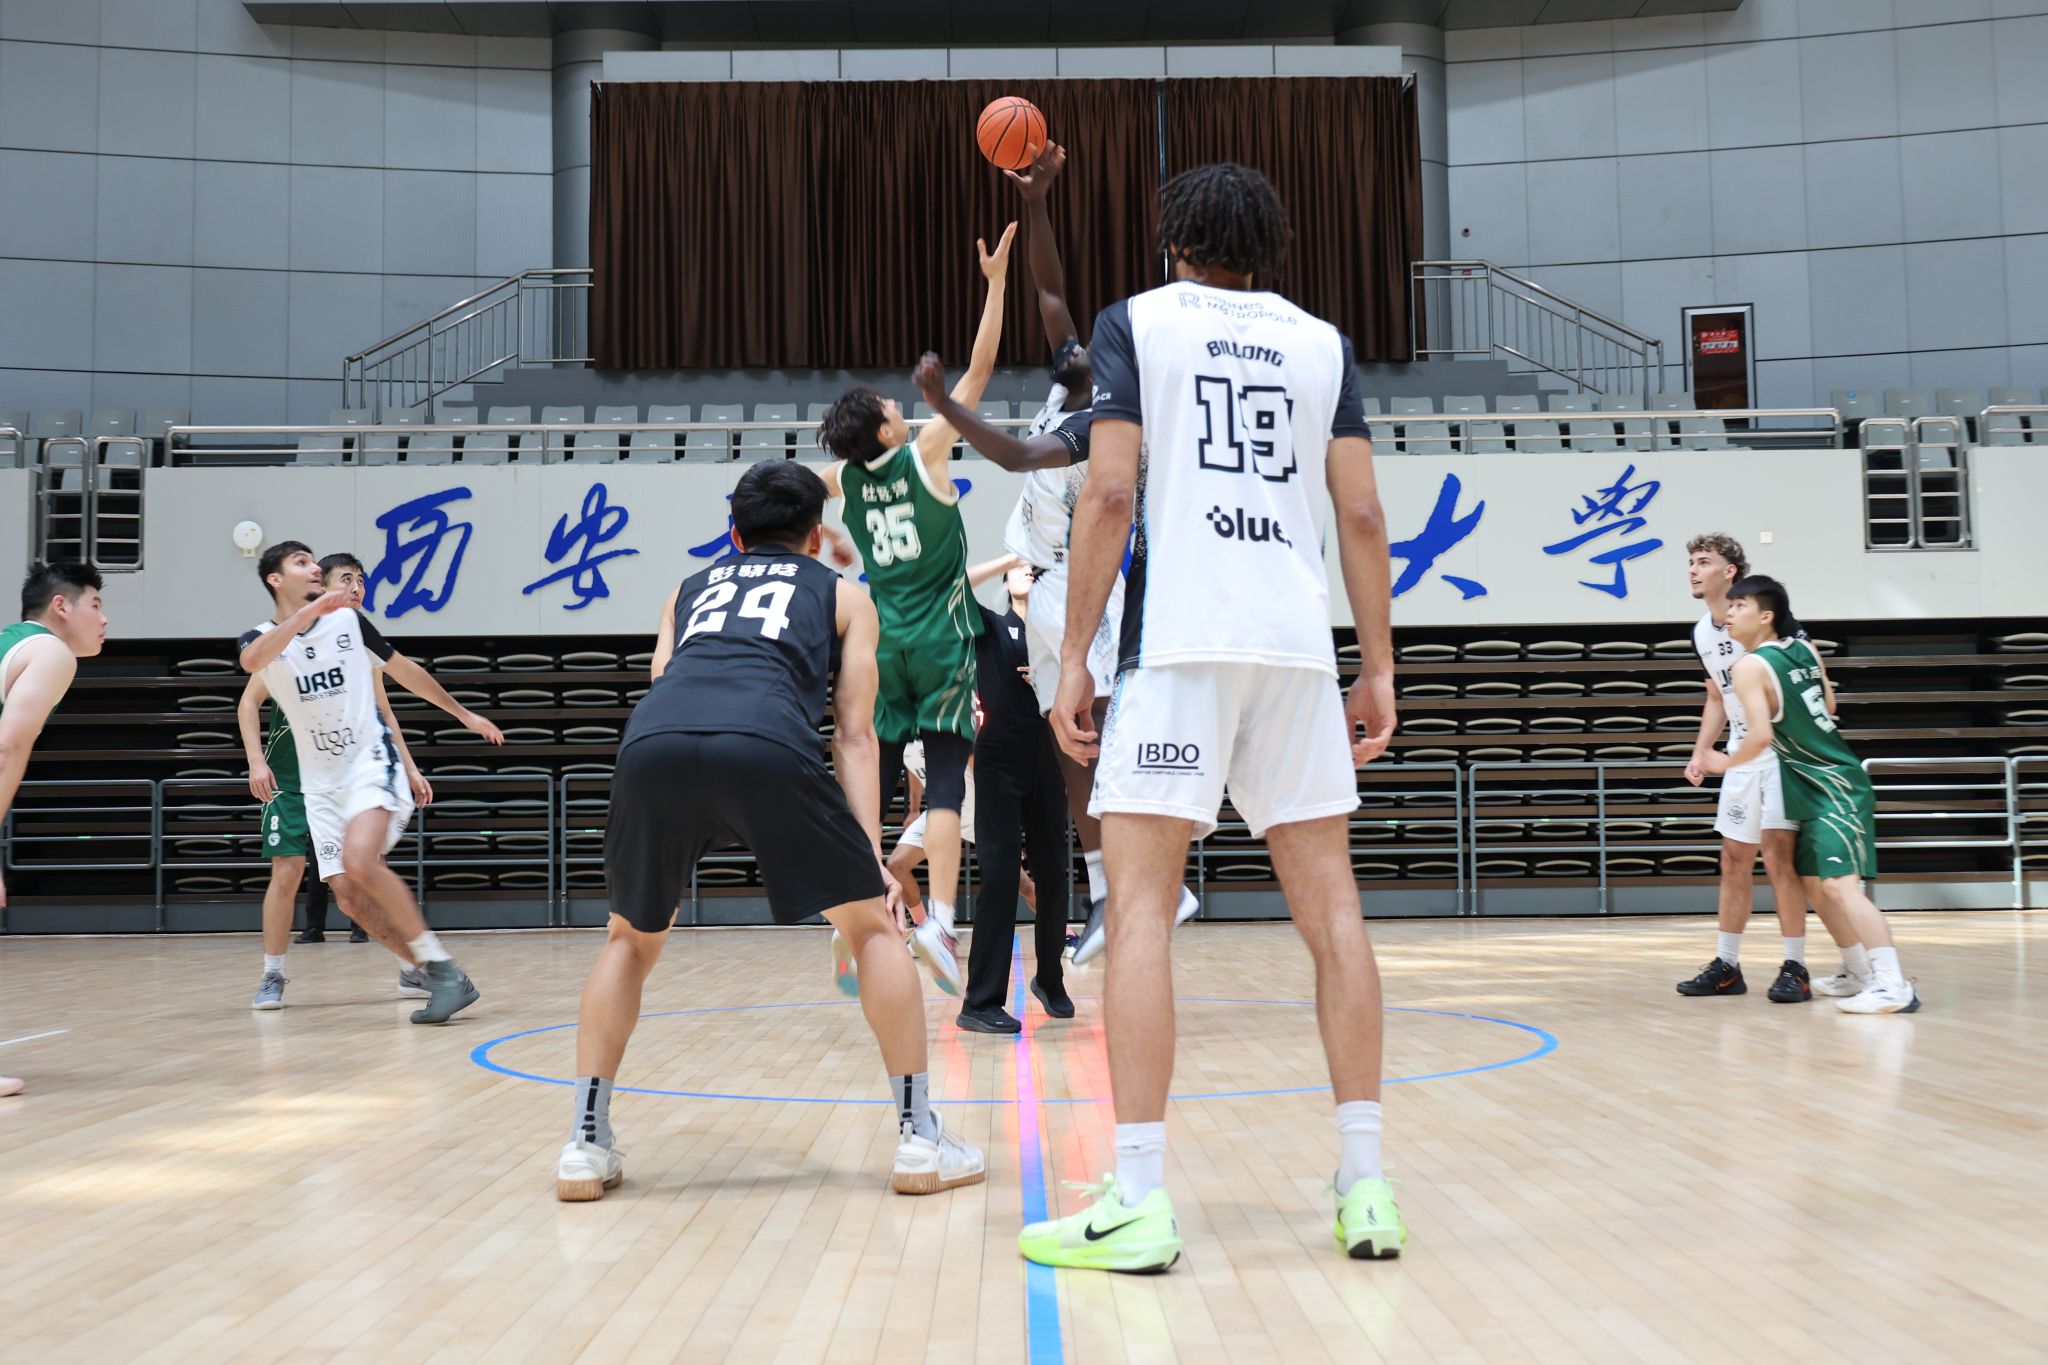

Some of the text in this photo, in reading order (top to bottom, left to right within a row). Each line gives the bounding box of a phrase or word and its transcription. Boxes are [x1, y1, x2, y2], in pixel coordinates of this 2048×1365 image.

[1206, 339, 1285, 367] BILLONG
[1195, 375, 1298, 483] 19
[865, 501, 922, 568] 35
[678, 580, 798, 648] 24
[295, 666, 345, 695] URB
[310, 727, 356, 756] itga
[1145, 743, 1200, 764] BDO
[270, 815, 280, 831] 8
